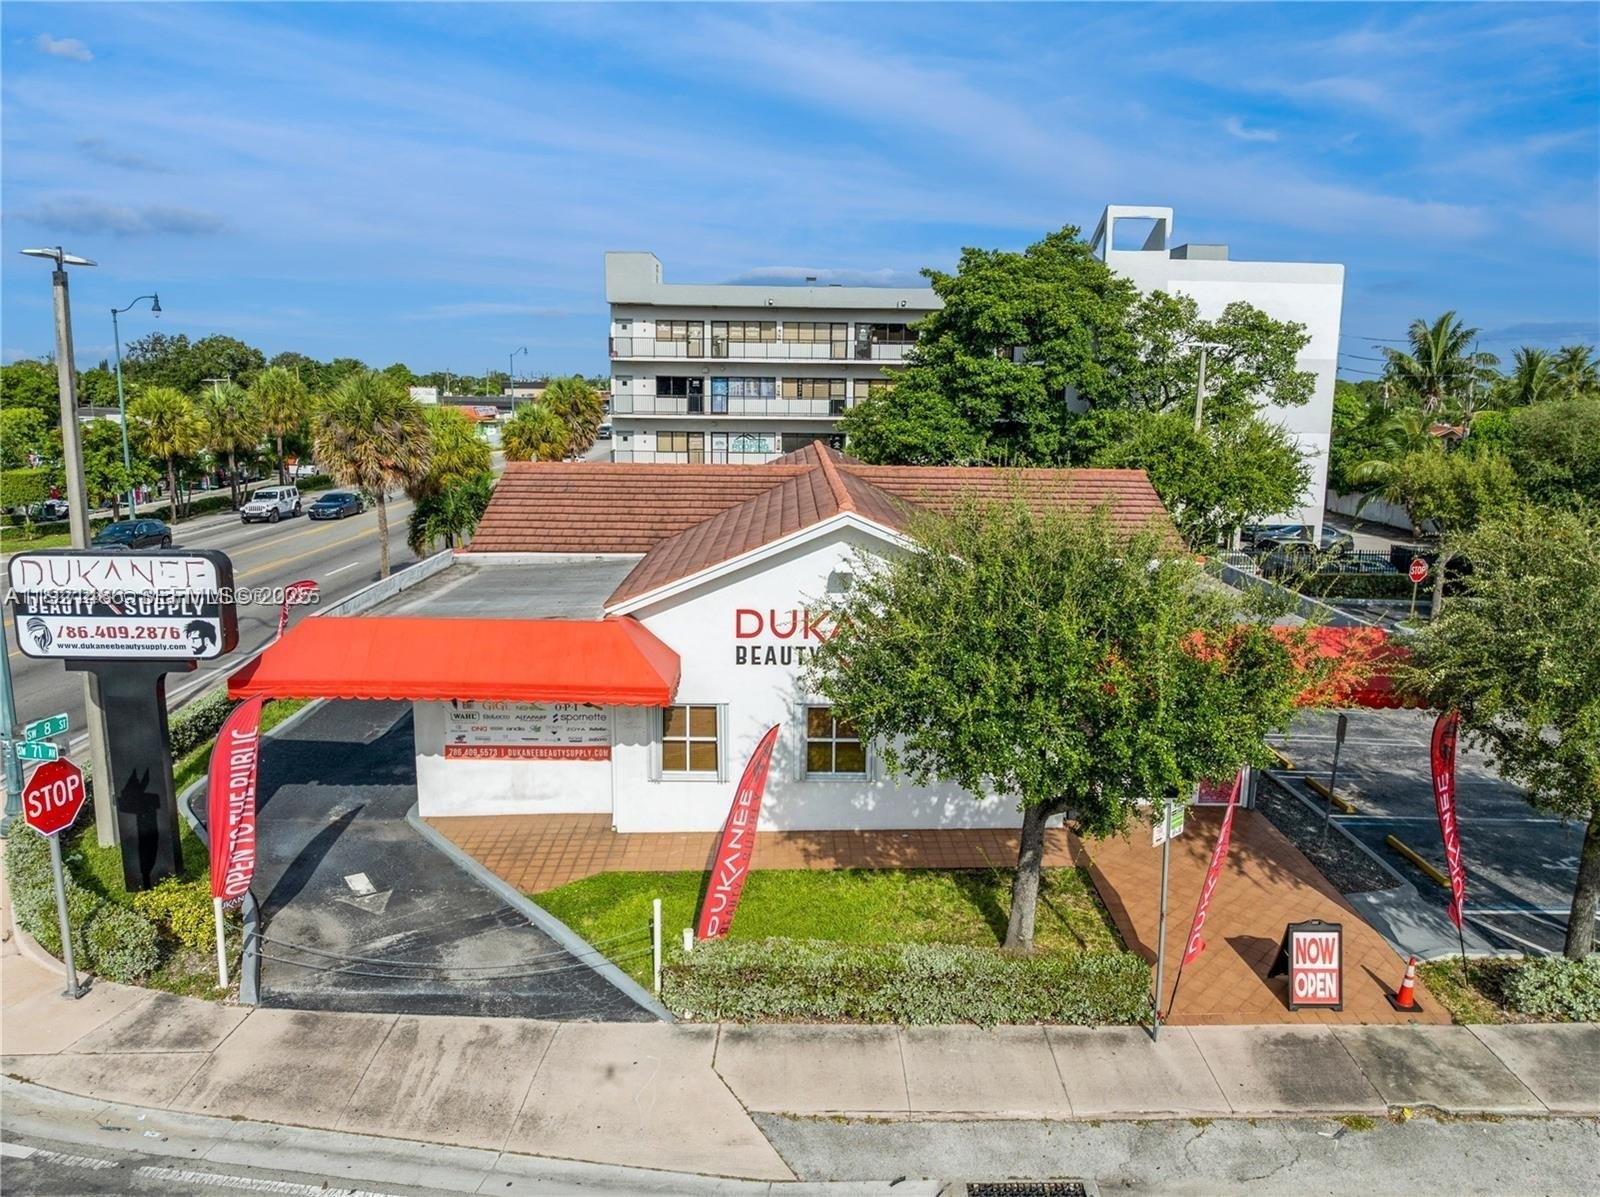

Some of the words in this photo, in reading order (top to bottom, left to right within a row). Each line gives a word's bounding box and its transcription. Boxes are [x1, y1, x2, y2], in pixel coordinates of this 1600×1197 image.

[20, 560, 206, 589] DUKANEE
[1411, 566, 1426, 575] STOP
[57, 643, 187, 651] www.dukaneebeautysupply.com
[44, 721, 52, 735] 8
[58, 719, 66, 730] ST
[31, 744, 42, 758] 71
[28, 774, 79, 818] STOP
[225, 849, 254, 895] OPEN
[707, 788, 753, 937] DUKANEE
[1295, 937, 1336, 966] NOW
[1294, 972, 1337, 999] OPEN
